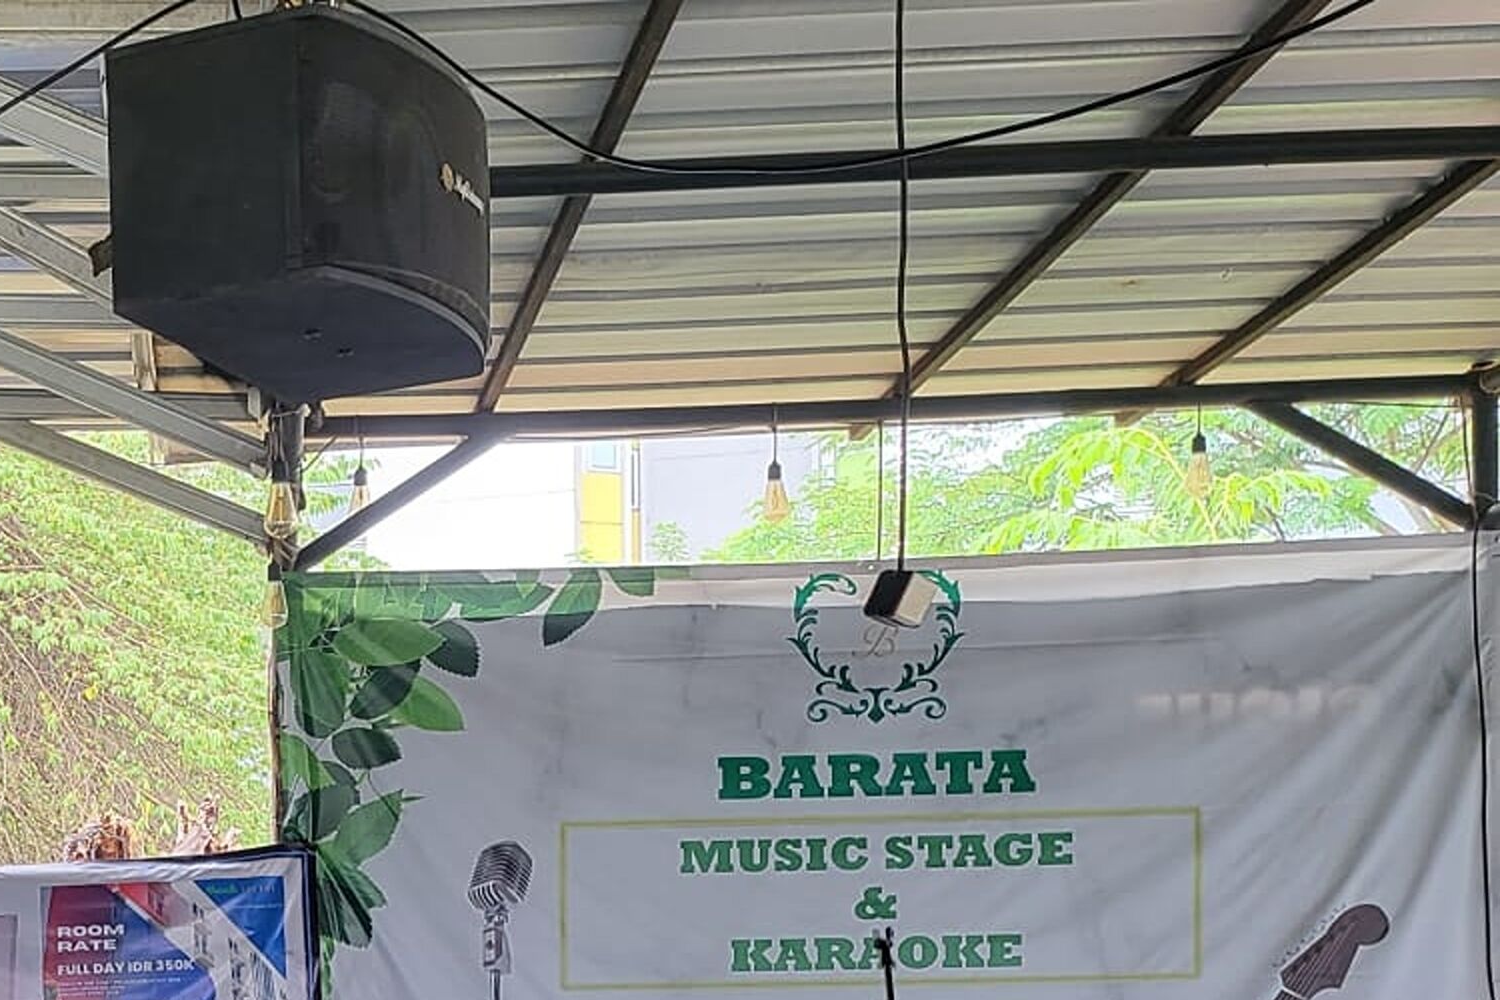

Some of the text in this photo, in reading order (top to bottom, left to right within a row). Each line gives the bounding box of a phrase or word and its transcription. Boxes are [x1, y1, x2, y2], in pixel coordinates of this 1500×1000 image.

[716, 749, 1036, 801] BARATA
[680, 831, 1074, 874] MUSIC STAGE
[854, 887, 897, 920] &
[57, 924, 124, 938] ROOM
[57, 939, 117, 953] RATE
[57, 963, 91, 976] FULL
[93, 961, 125, 974] DAY
[128, 961, 152, 972] IDR
